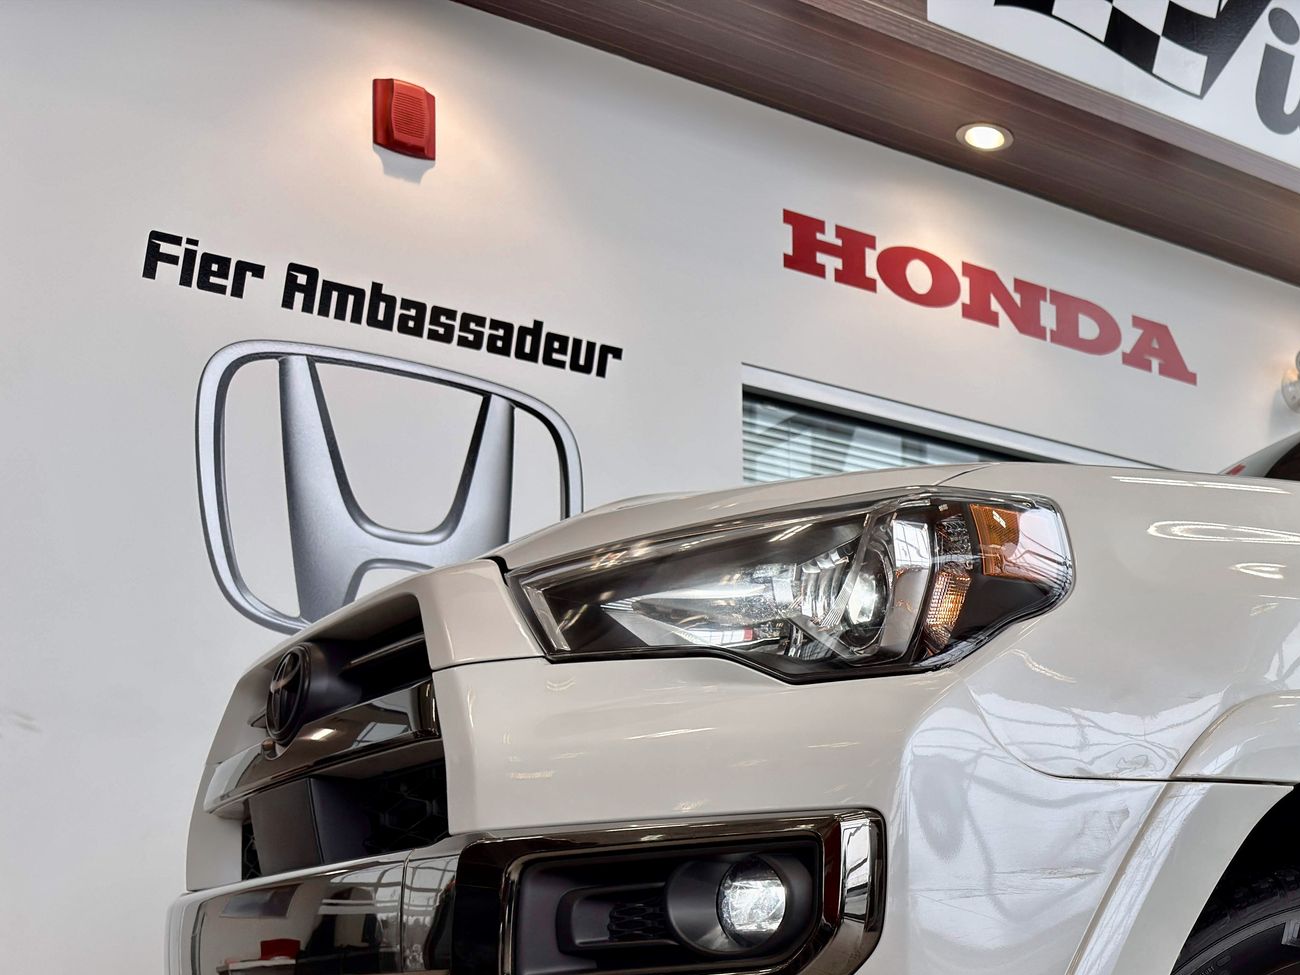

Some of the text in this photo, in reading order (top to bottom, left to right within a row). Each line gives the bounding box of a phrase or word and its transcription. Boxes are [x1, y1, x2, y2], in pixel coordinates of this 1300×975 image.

[142, 230, 623, 378] Fier Ambassadeur
[783, 208, 1197, 386] HONDA
